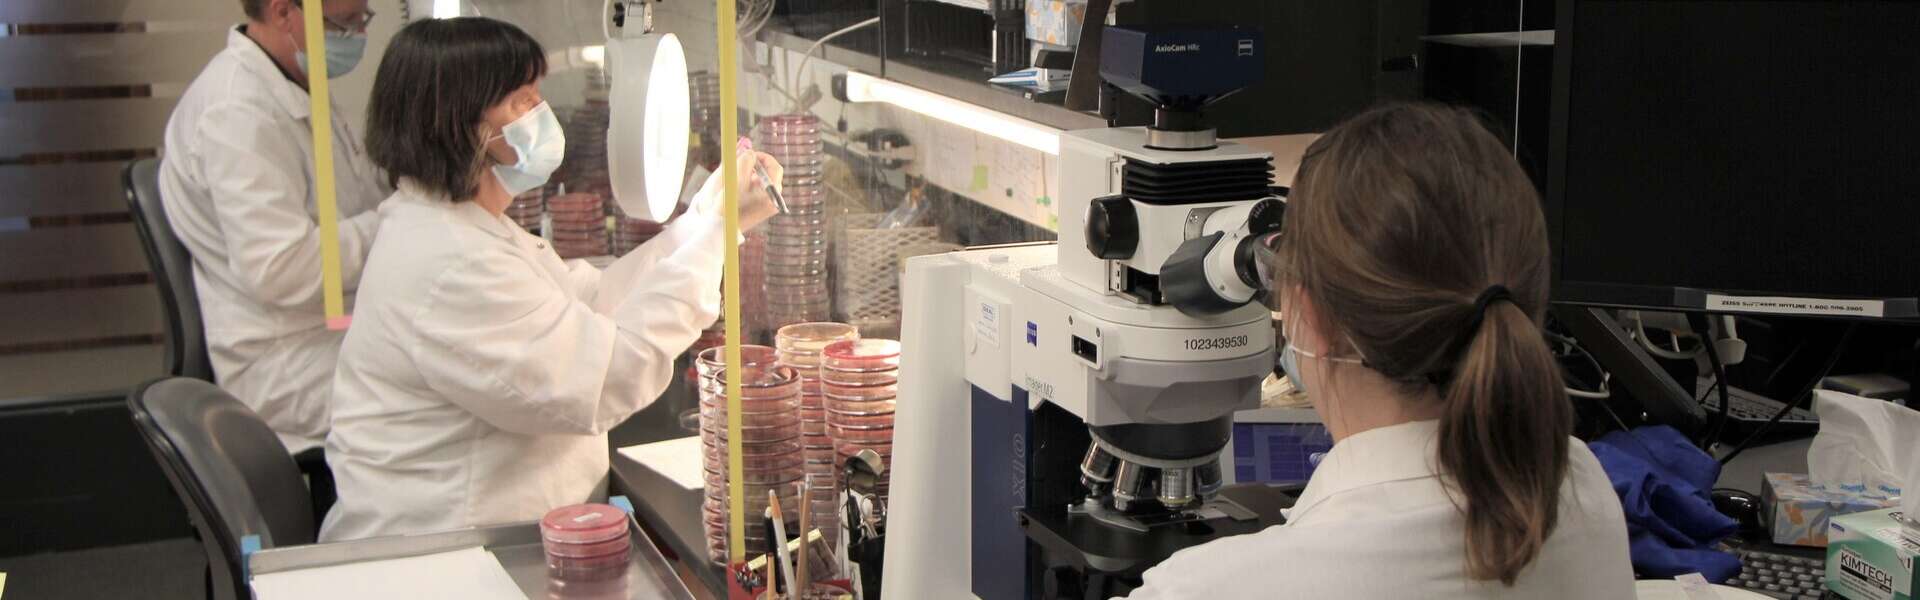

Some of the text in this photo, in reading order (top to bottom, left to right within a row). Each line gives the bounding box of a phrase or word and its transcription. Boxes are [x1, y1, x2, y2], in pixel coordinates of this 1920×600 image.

[1155, 44, 1186, 53] AxioCam
[1184, 335, 1248, 350] 1023439530
[1841, 551, 1893, 587] KIMTECH
